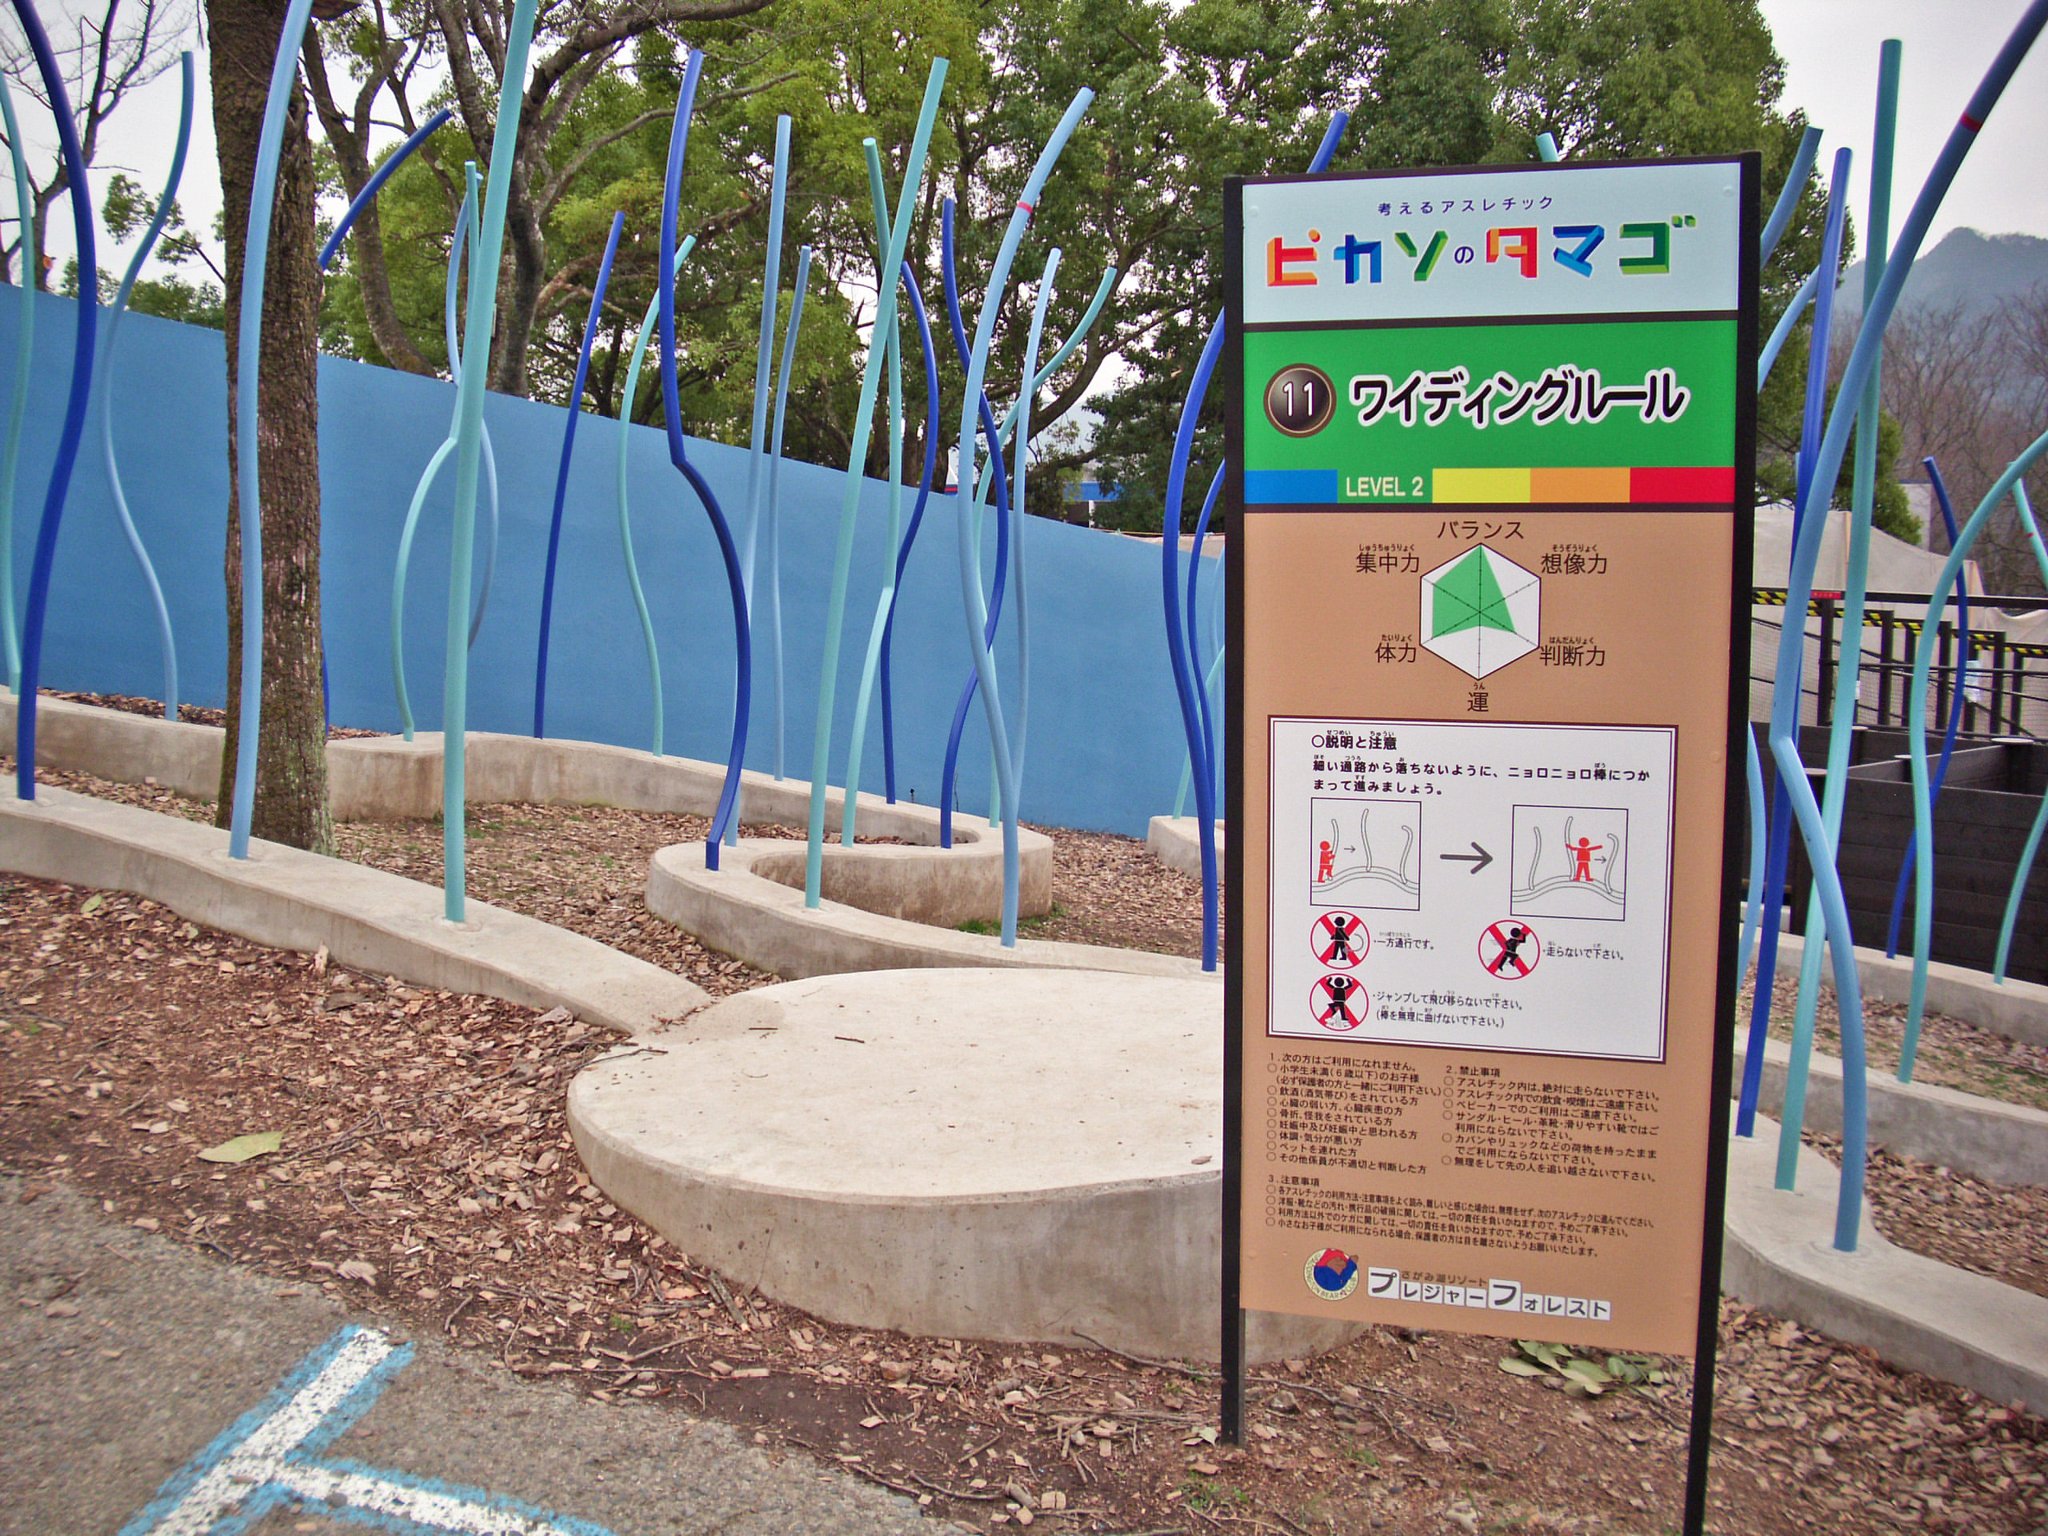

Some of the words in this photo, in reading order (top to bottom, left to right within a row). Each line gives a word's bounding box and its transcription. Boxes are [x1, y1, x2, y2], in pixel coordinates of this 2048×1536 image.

[1377, 196, 1553, 217] 考えるアスレチック
[1267, 215, 1697, 287] ピカソのタマゴ
[1282, 381, 1314, 417] 11
[1352, 364, 1691, 429] ワイディングルール
[1346, 476, 1406, 497] LEVEL
[1411, 476, 1424, 496] 2
[1437, 520, 1524, 540] バランス
[1359, 544, 1415, 552] しゅうちゅうりょく
[1552, 544, 1598, 552] そうぞうりょく
[1356, 552, 1420, 574] 集中力
[1541, 553, 1608, 575] 想像力
[1381, 634, 1413, 642] たいりょく
[1375, 643, 1417, 664] 体力
[1539, 645, 1606, 667] 判断力
[1473, 682, 1486, 690] うん
[1467, 691, 1489, 712] 運
[1314, 779, 1442, 796] まって進みましょう。
[1456, 1123, 1573, 1140] 利用にならないで下さい。
[1369, 1269, 1609, 1319] プレジャーフォレスト
